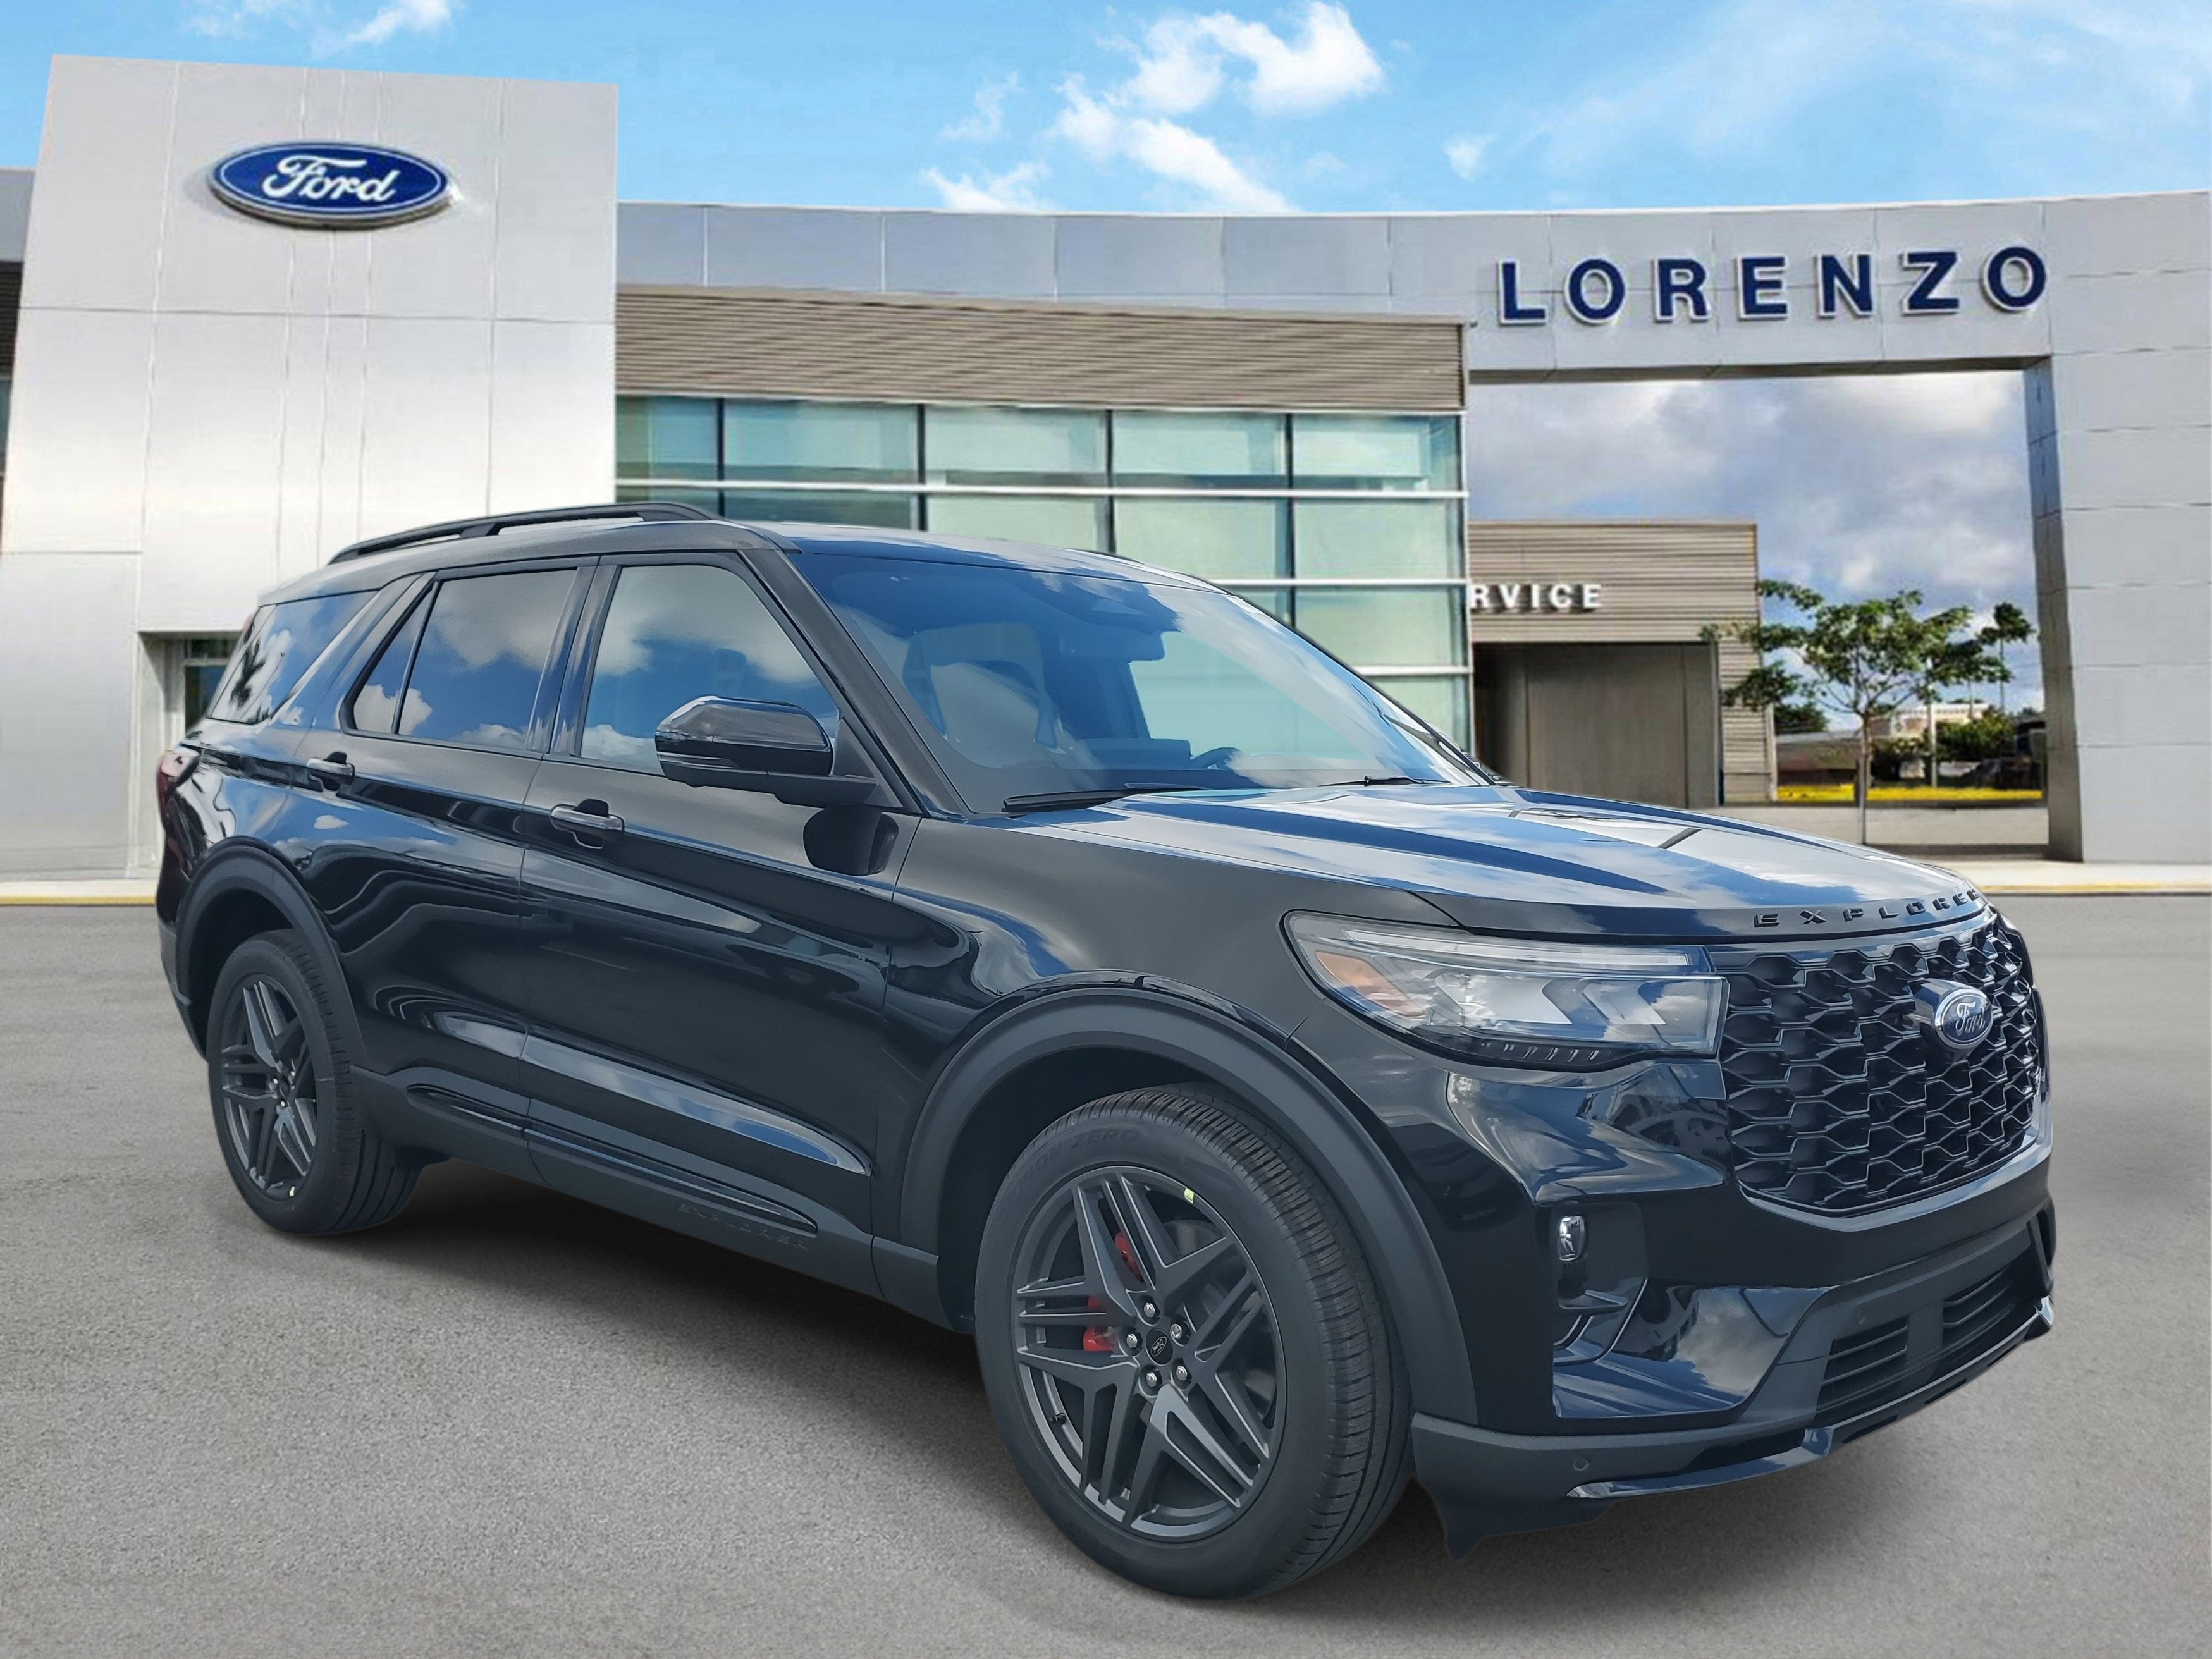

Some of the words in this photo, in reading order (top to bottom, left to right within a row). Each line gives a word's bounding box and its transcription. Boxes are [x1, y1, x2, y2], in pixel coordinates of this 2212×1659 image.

[262, 154, 400, 202] Ford
[1499, 246, 2048, 324] LORENZO
[1470, 583, 1603, 609] RVICE
[1955, 1001, 1986, 1036] Ford
